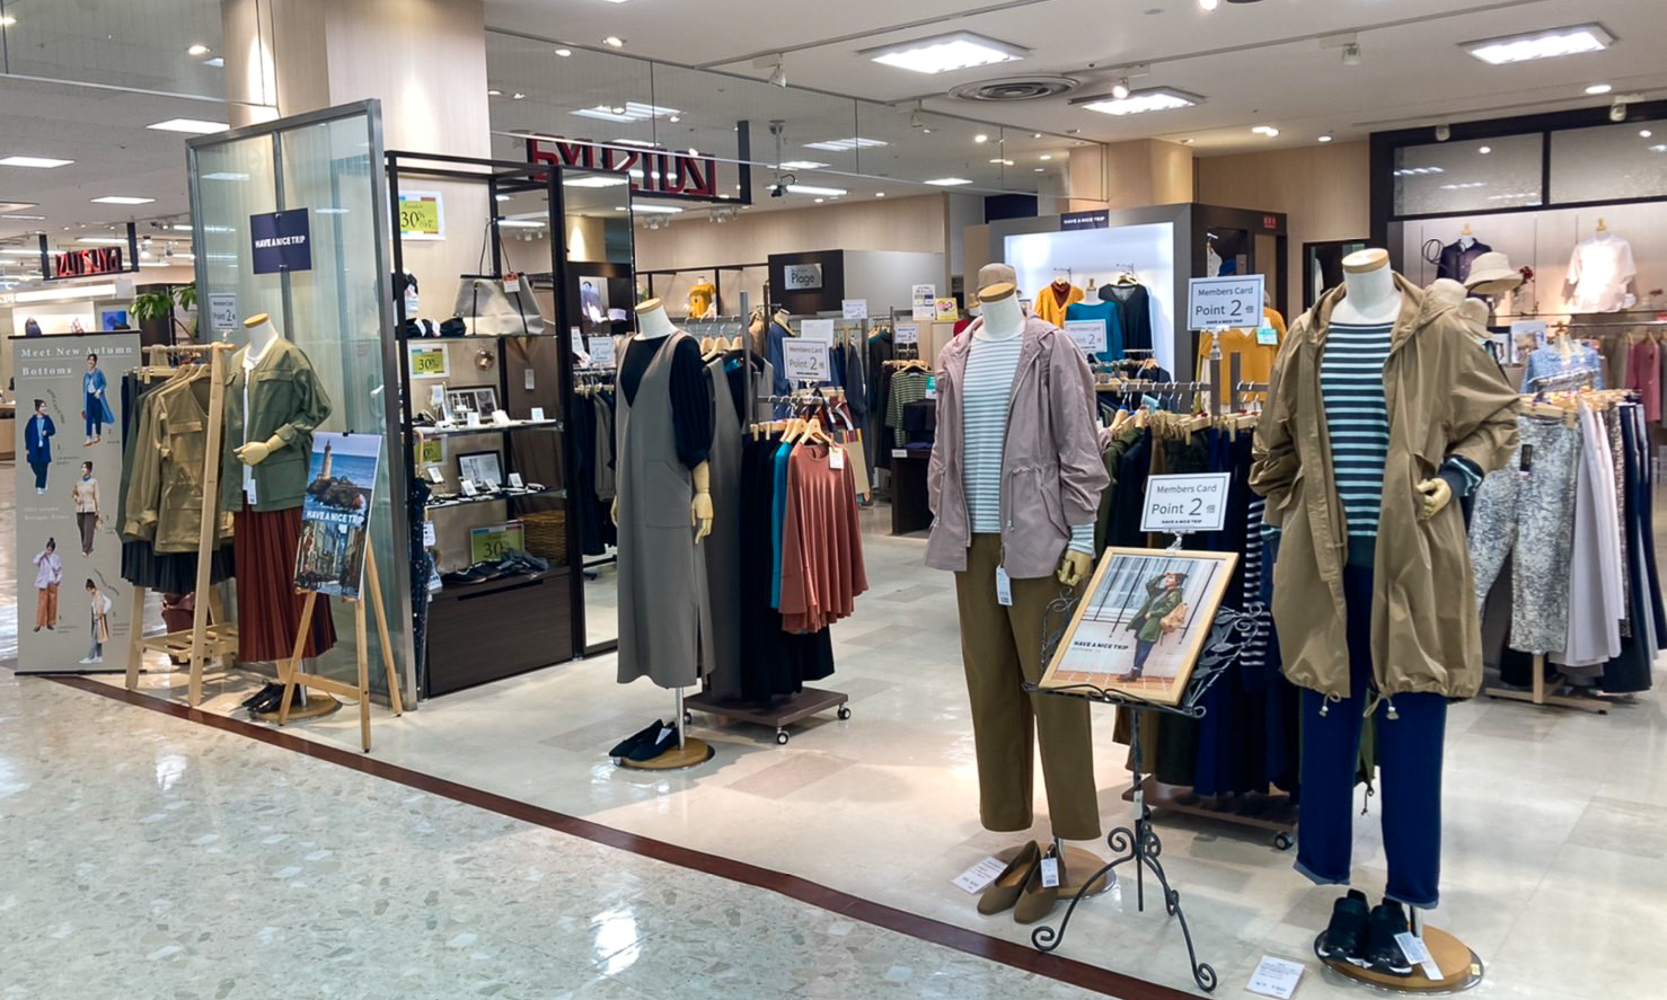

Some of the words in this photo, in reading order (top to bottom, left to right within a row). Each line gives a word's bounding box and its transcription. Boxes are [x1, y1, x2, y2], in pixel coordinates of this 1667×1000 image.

[255, 238, 271, 248] HAVE
[271, 238, 276, 247] A
[276, 236, 291, 246] NICE
[291, 235, 306, 244] TRIP
[791, 272, 815, 286] Plage
[1198, 288, 1233, 296] Members
[1234, 286, 1253, 294] Card
[1195, 304, 1225, 316] Point
[1229, 299, 1242, 316] 2
[226, 309, 232, 321] 2
[1088, 333, 1095, 345] 2
[21, 348, 51, 357] Meet
[56, 347, 80, 356] New
[85, 346, 132, 355] Autumn
[788, 358, 808, 368] Point
[810, 356, 818, 370] 2
[22, 366, 72, 376] Bottoms
[1156, 485, 1195, 493] Members
[1196, 484, 1217, 492] Card
[1151, 503, 1184, 514] Point
[1188, 497, 1203, 516] 2
[306, 510, 325, 520] HAVE
[325, 511, 330, 520] A
[330, 512, 348, 522] NICE
